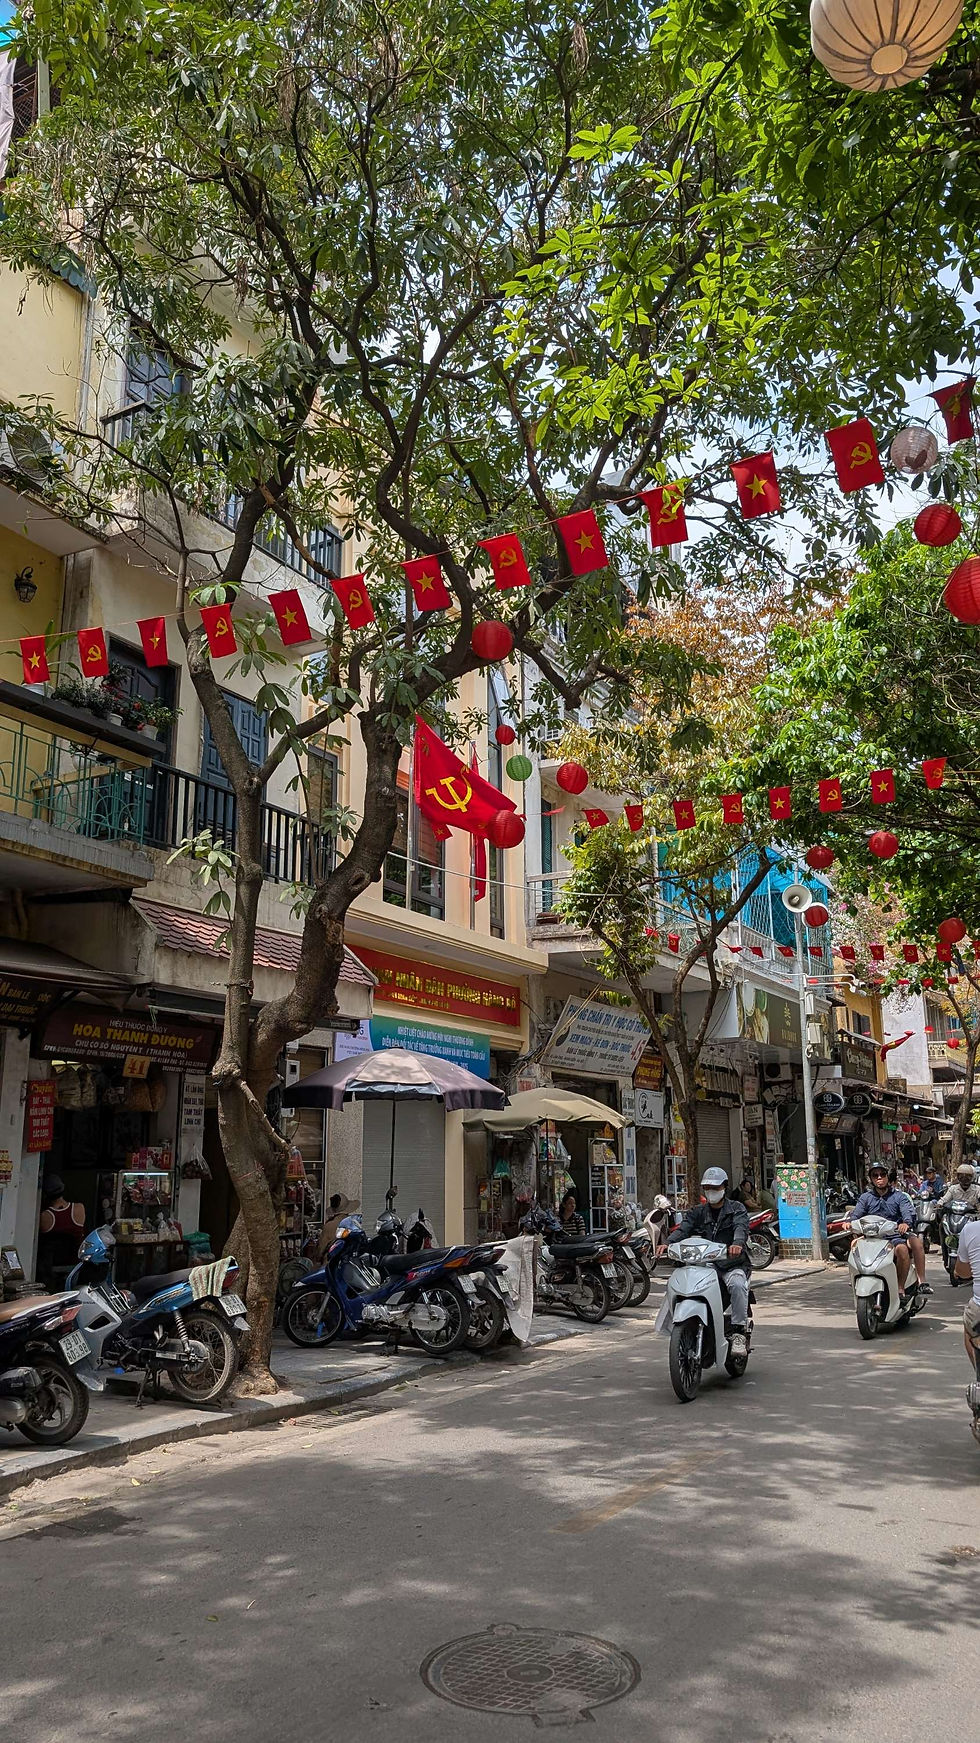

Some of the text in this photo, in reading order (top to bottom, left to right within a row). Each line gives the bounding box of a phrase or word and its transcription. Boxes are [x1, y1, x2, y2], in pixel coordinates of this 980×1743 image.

[395, 971, 423, 992] NHÂN
[425, 976, 445, 997] DÂN
[566, 1004, 589, 1021] PHNG
[106, 1028, 149, 1044] THANH
[630, 1039, 647, 1061] 45
[128, 1058, 146, 1075] 41
